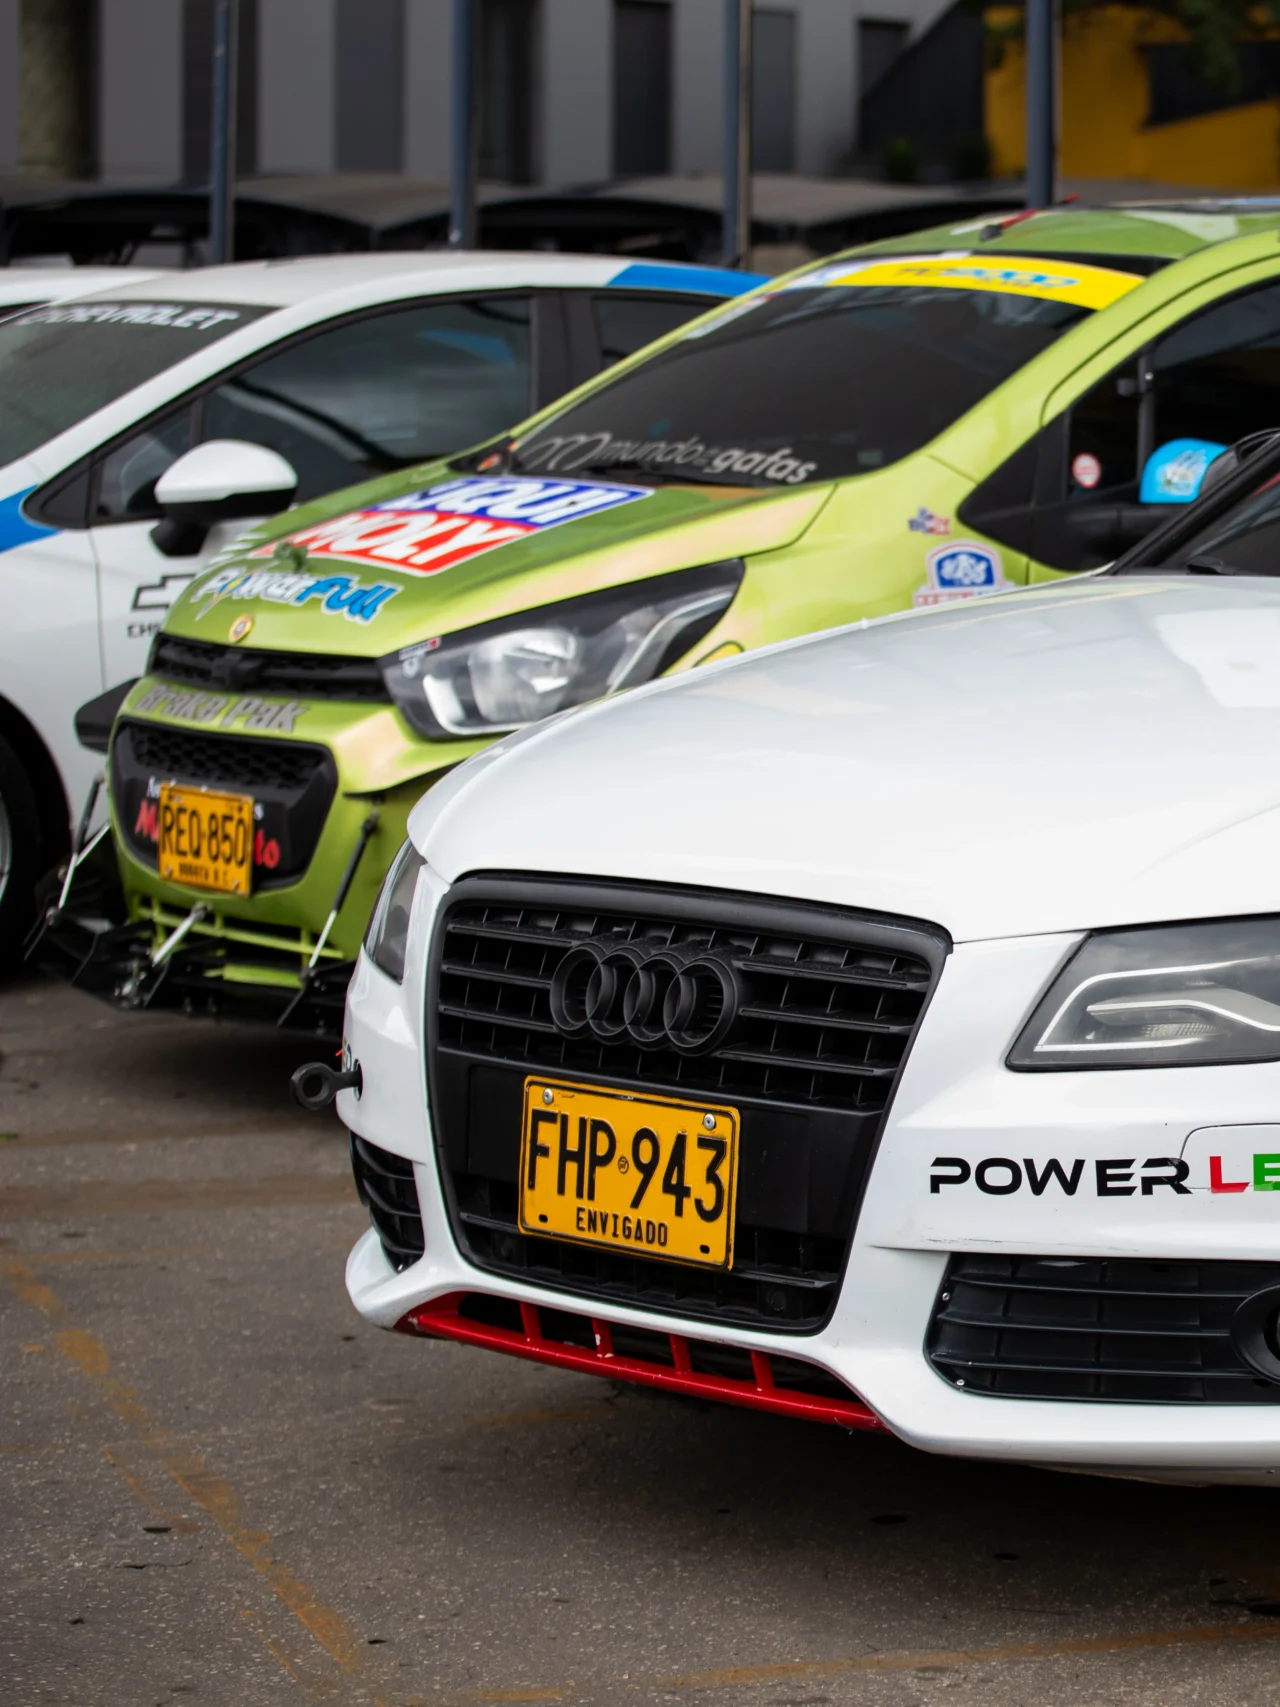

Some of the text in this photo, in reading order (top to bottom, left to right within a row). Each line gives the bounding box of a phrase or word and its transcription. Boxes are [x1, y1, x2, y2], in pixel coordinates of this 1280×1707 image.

[702, 447, 817, 484] gafas
[288, 510, 530, 566] MOLY
[220, 696, 308, 732] Pak
[576, 1206, 669, 1248] ENVIGADO
